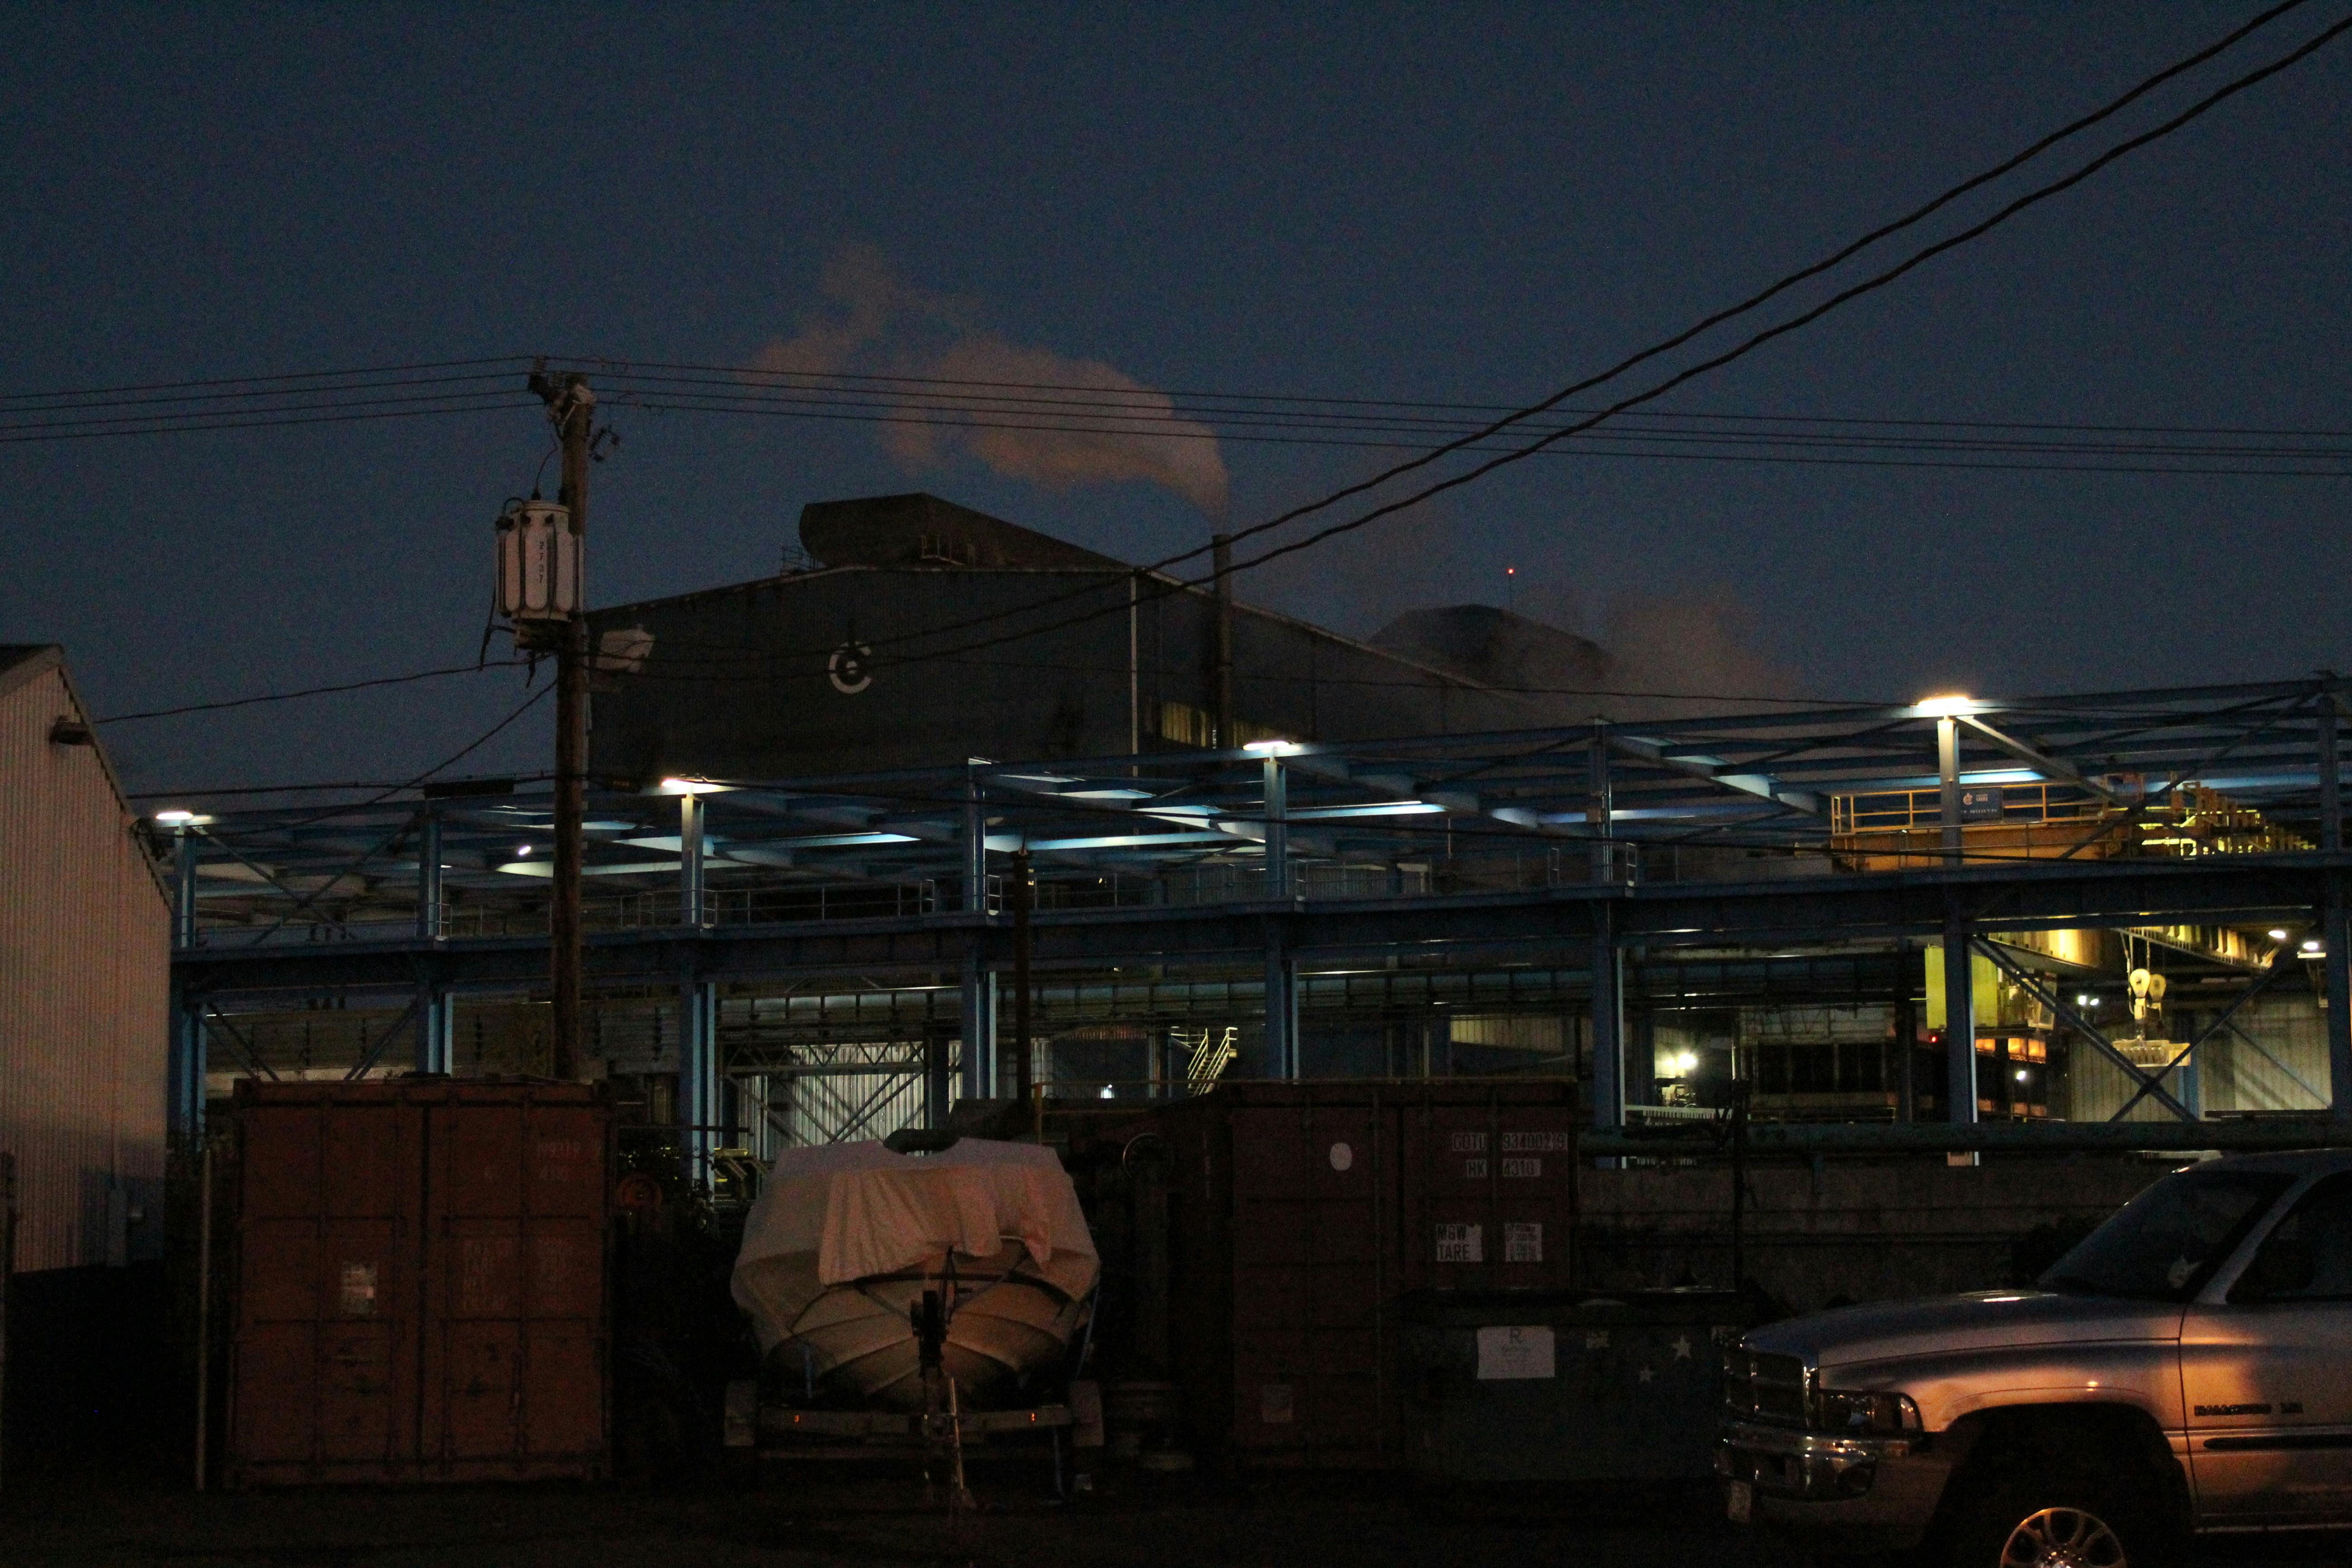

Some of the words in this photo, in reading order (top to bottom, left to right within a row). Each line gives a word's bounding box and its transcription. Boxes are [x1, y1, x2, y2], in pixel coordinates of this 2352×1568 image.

[1468, 1161, 1485, 1176] HK
[1437, 1225, 1466, 1240] MGW
[1438, 1244, 1470, 1260] TARE
